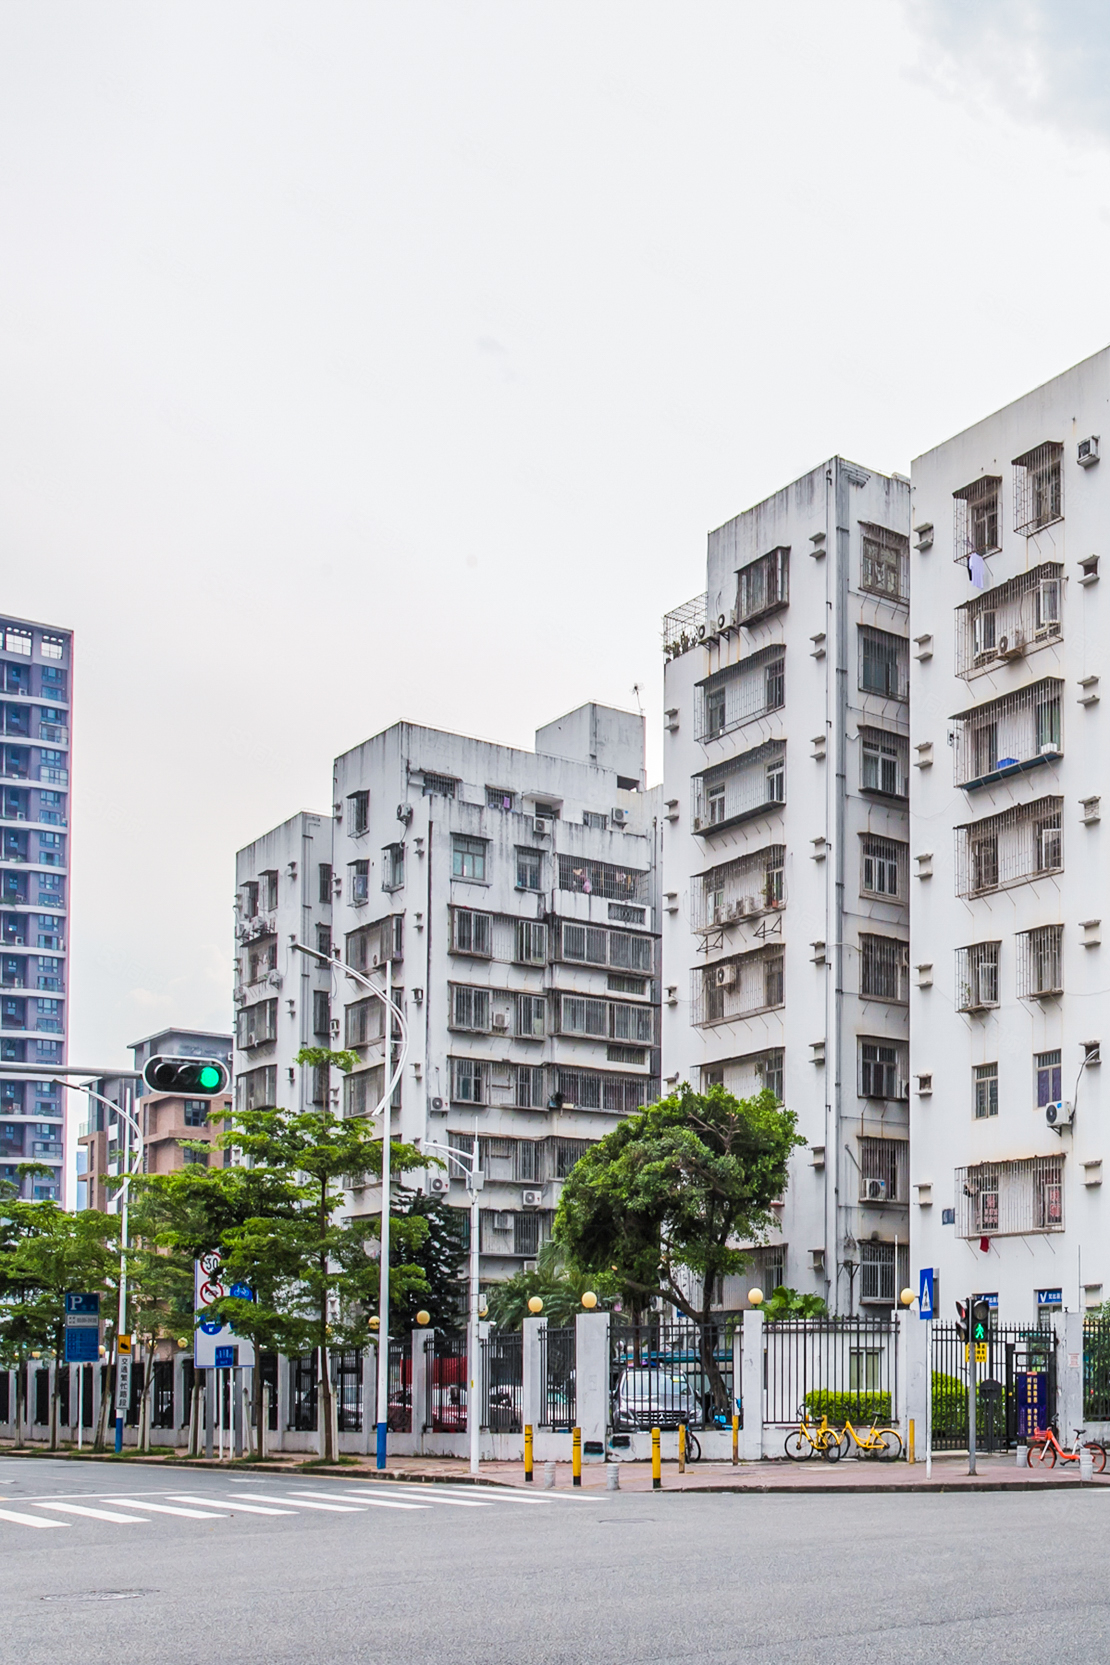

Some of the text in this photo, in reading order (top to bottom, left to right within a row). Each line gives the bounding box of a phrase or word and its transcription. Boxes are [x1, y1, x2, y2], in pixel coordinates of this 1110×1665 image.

[206, 1258, 218, 1270] 30
[70, 1296, 83, 1310] P
[119, 1357, 128, 1406] 交通繁忙路段
